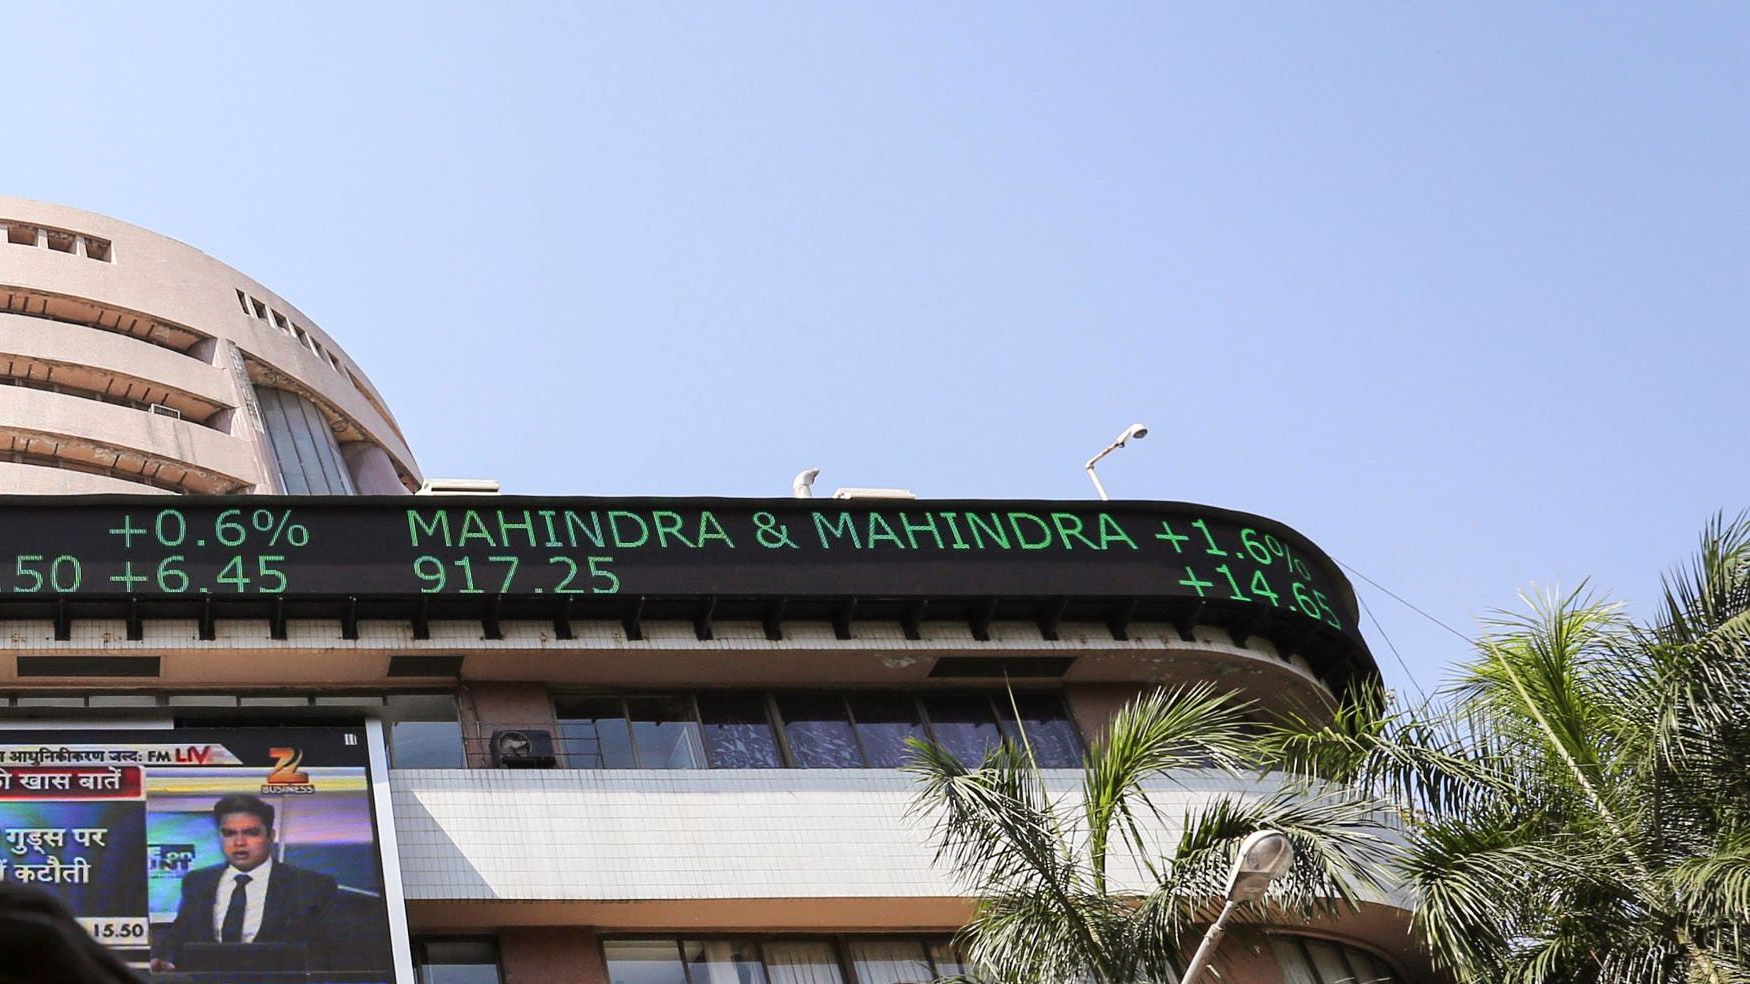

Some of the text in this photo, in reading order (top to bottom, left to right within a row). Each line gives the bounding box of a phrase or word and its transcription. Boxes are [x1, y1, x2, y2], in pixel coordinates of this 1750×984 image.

[109, 509, 310, 547] +0.6%
[407, 510, 1312, 582] MAHINDRA & MAHINDRA +1.6%
[109, 554, 288, 593] +6.45
[413, 555, 621, 594] 917.25
[1179, 564, 1342, 630] +14.65
[148, 750, 171, 762] FM
[18, 772, 72, 790] खास
[77, 766, 122, 790] बातें
[5, 827, 66, 855] गुड्स
[72, 827, 108, 848] पर
[13, 856, 92, 884] कटौती
[93, 922, 145, 938] 15.50
